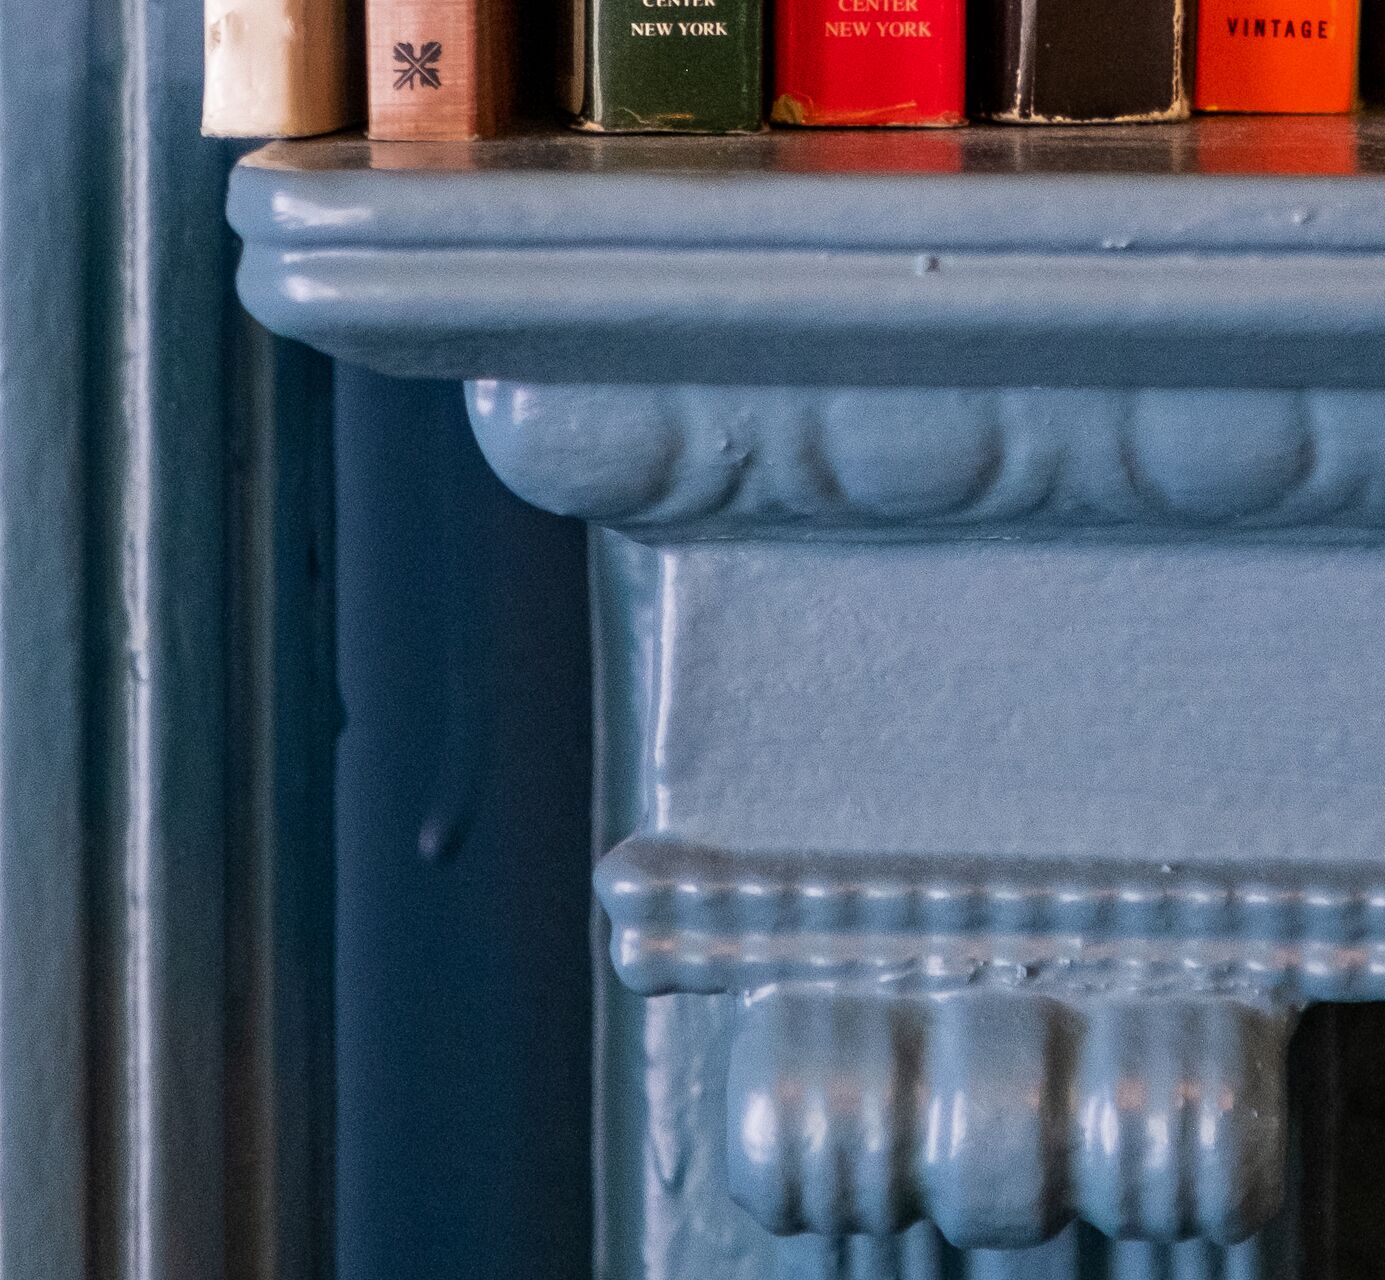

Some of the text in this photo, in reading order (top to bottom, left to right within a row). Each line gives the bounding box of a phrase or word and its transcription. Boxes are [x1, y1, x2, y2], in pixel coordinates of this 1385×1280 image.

[631, 22, 727, 36] NEW YORK
[826, 22, 931, 37] NEW YORK
[1227, 18, 1326, 38] VINTAGE
